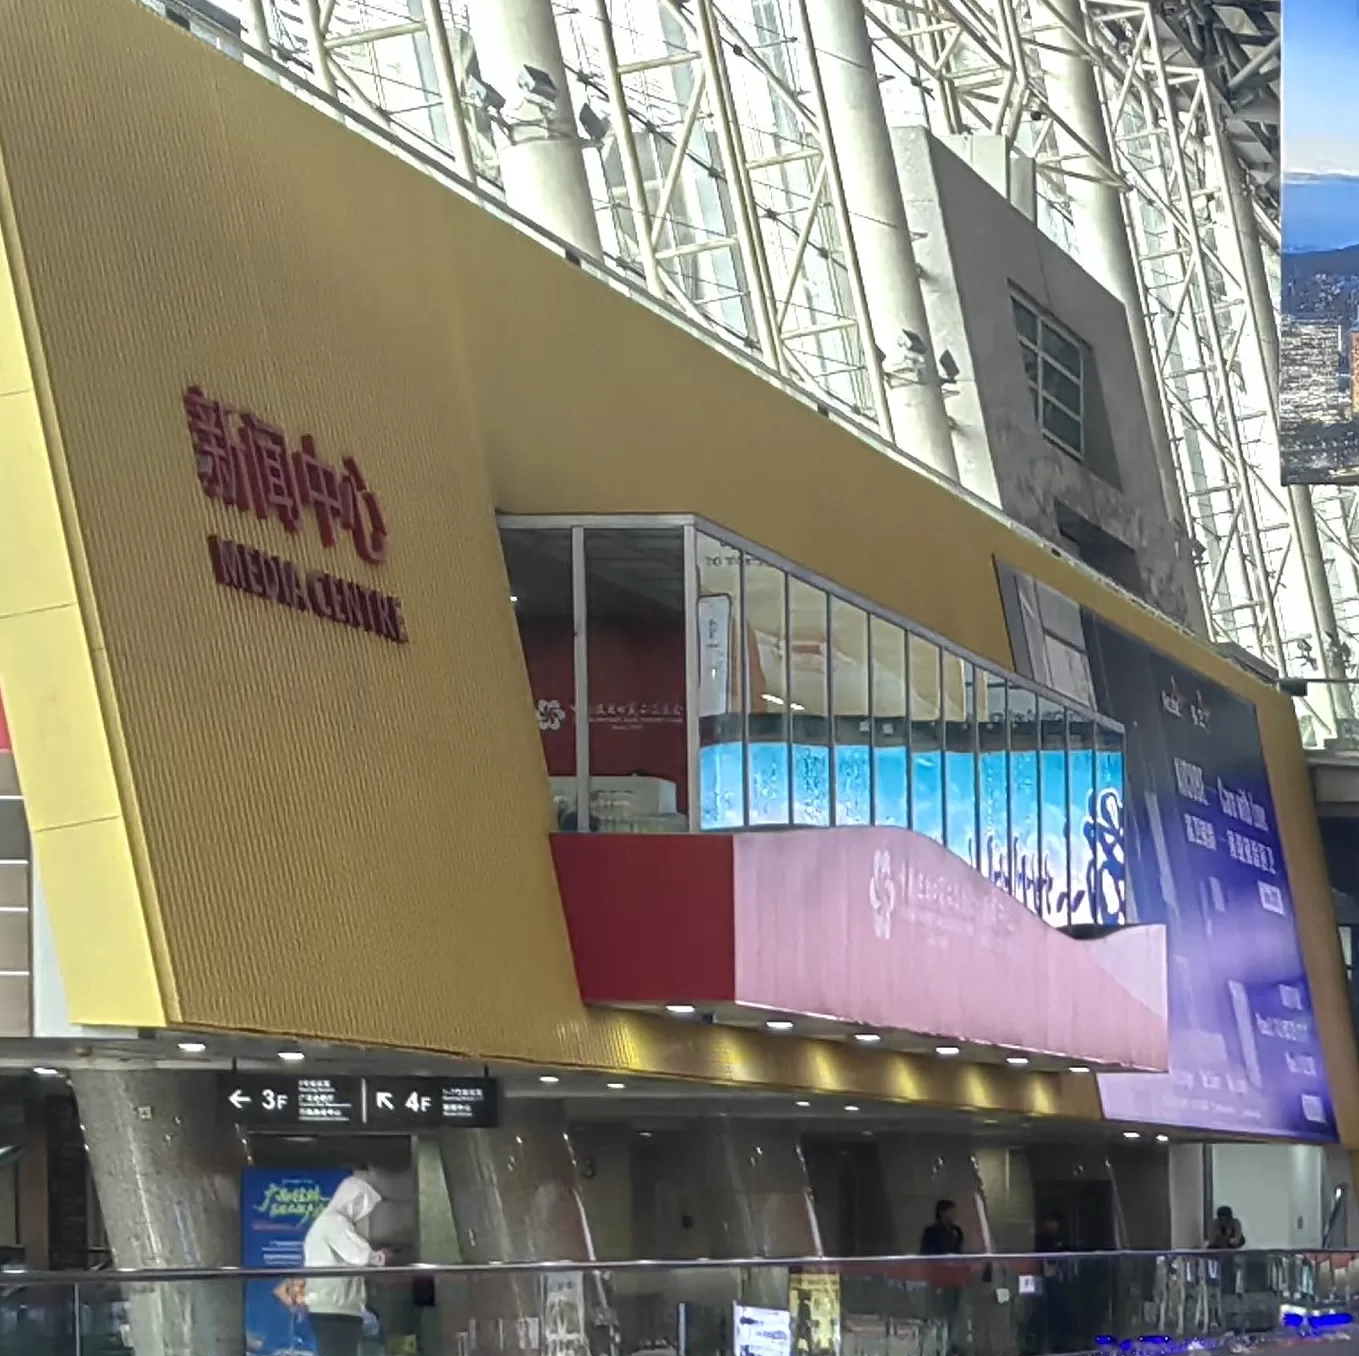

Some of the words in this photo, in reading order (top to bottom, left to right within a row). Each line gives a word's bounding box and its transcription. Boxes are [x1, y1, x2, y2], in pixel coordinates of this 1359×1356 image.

[184, 385, 388, 565] 新闻中心
[207, 534, 308, 613] MEDIA
[306, 569, 409, 644] CENTRE
[261, 1089, 288, 1110] 3F
[404, 1092, 432, 1112] 4F
